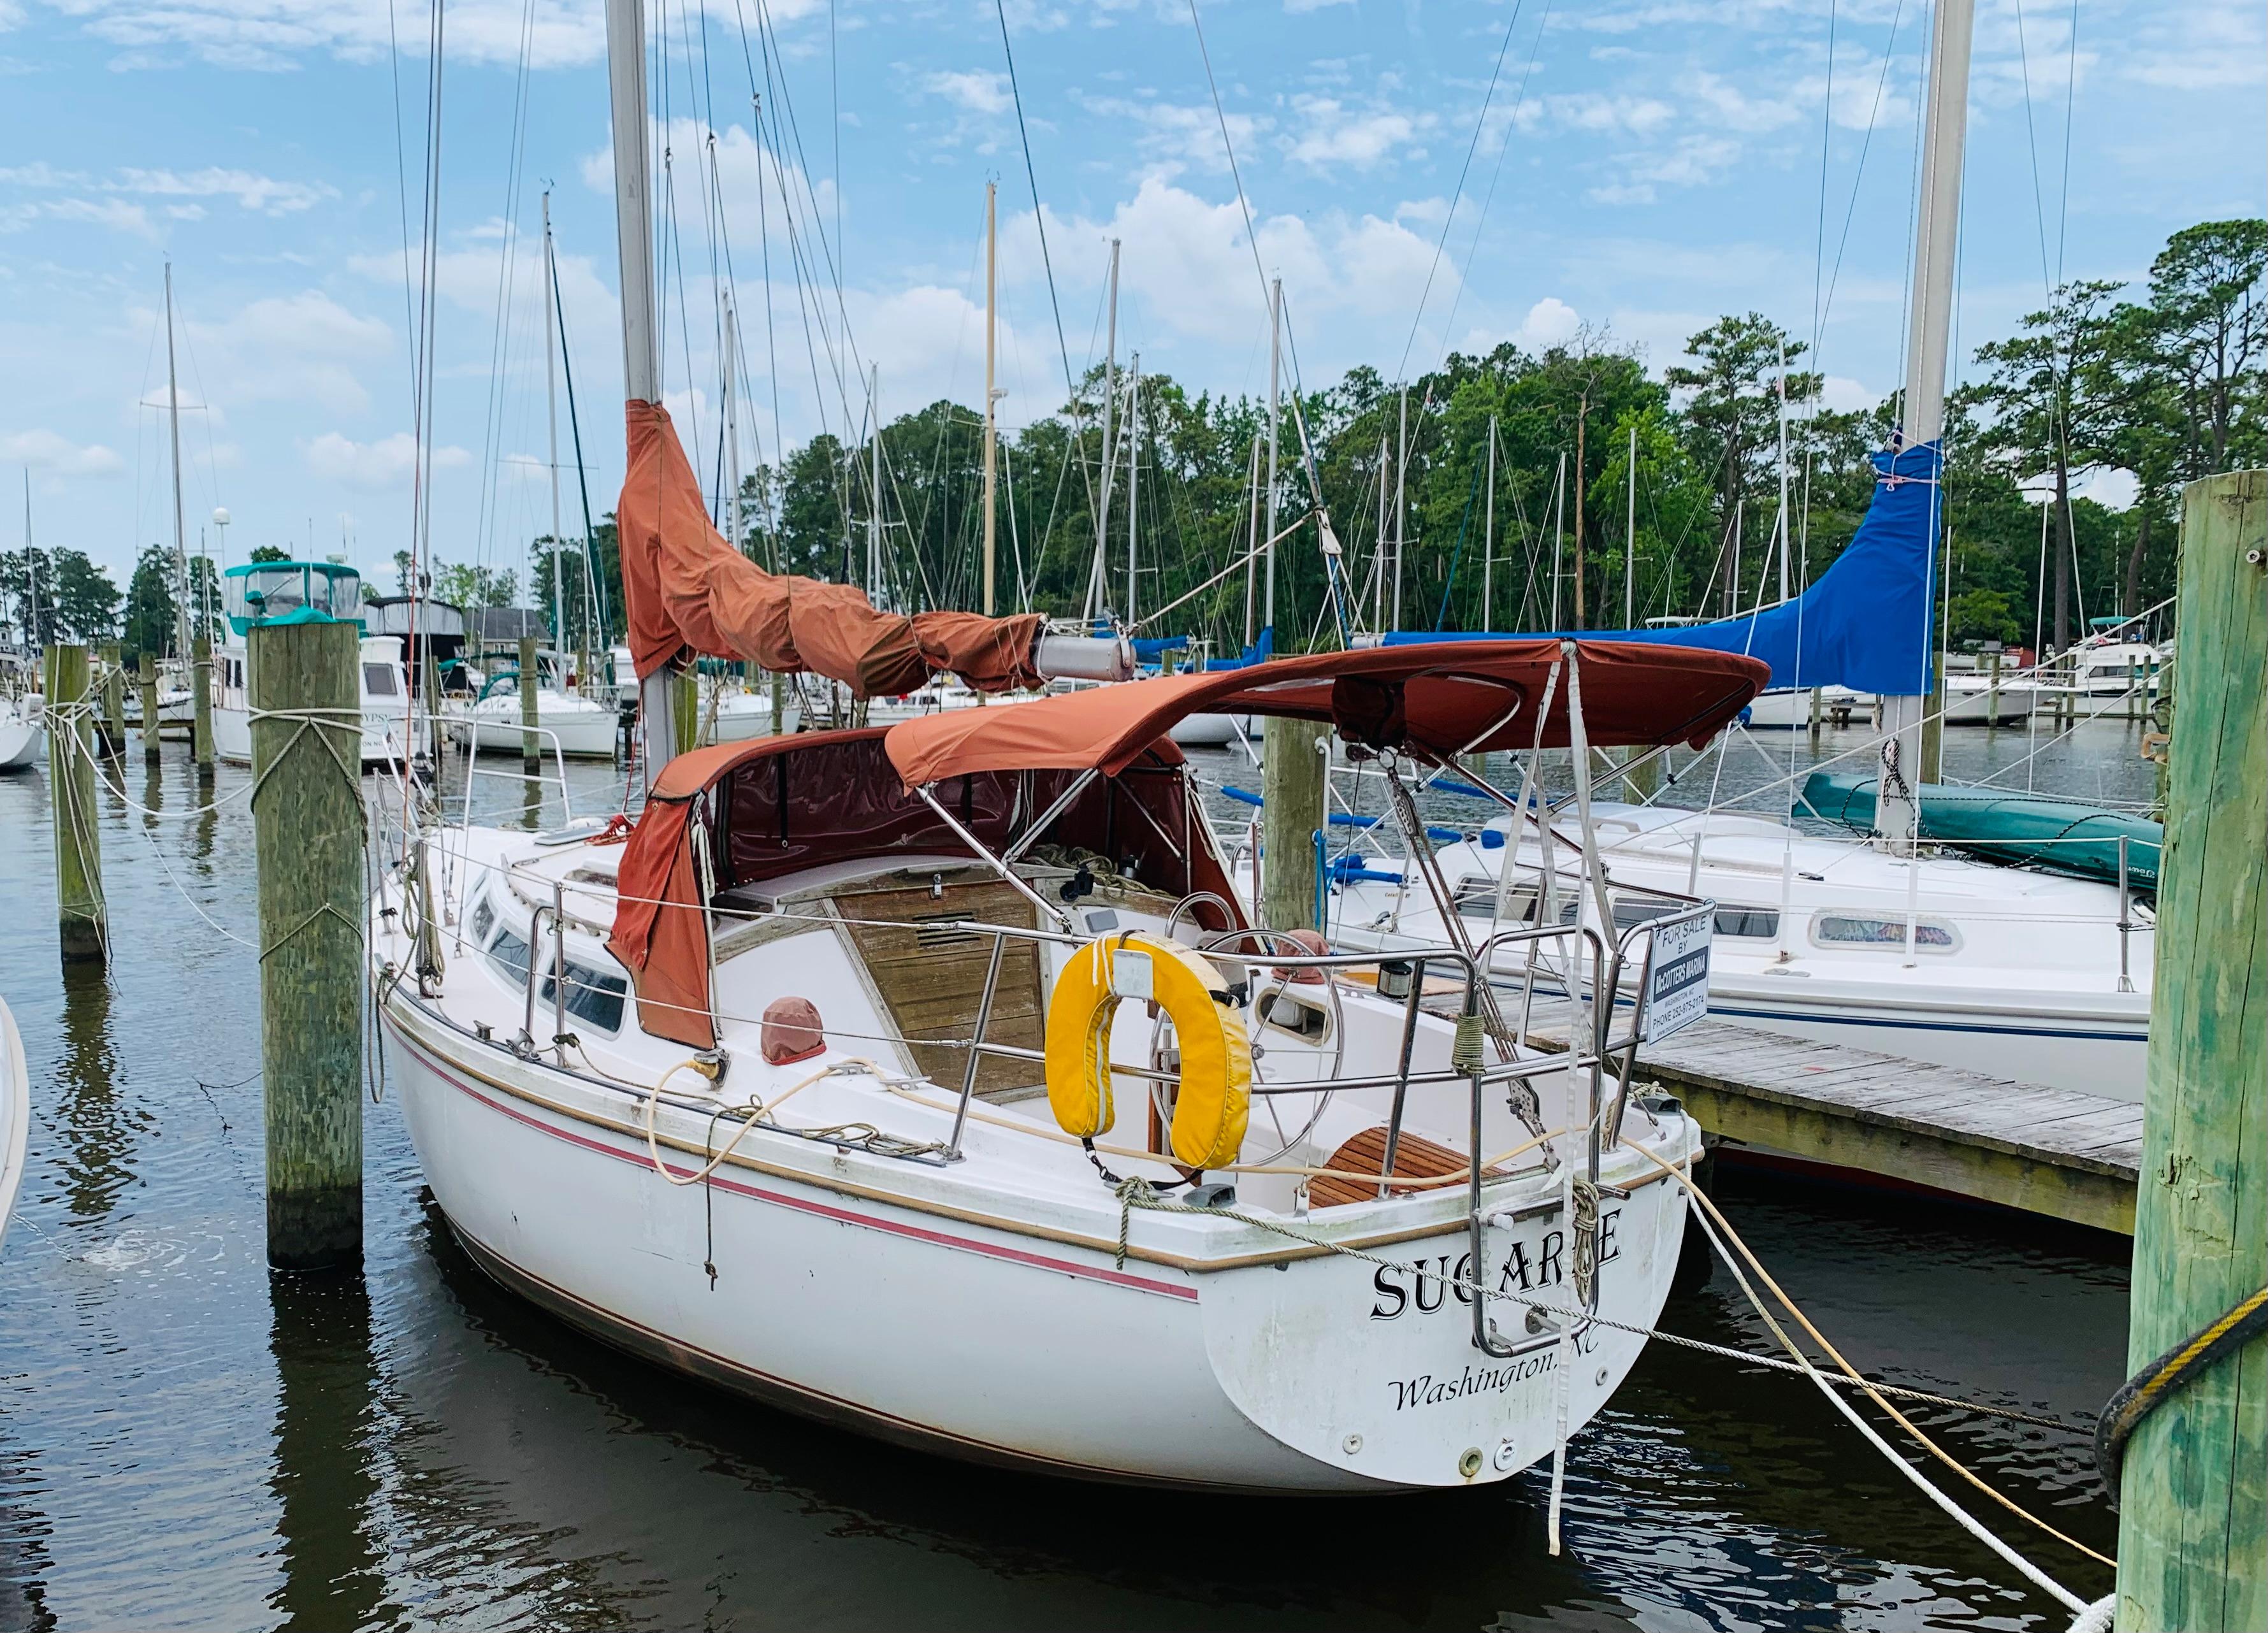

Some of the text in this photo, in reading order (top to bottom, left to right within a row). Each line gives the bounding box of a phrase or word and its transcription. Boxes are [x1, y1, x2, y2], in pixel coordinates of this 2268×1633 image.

[1663, 916, 1706, 947] FOR SALE
[1678, 940, 1687, 954] BY
[1655, 954, 1705, 994] McCOTTERS MARINA
[1653, 994, 1704, 1030] PHONE 252-975-2174
[1388, 1352, 1557, 1411] Washington,
